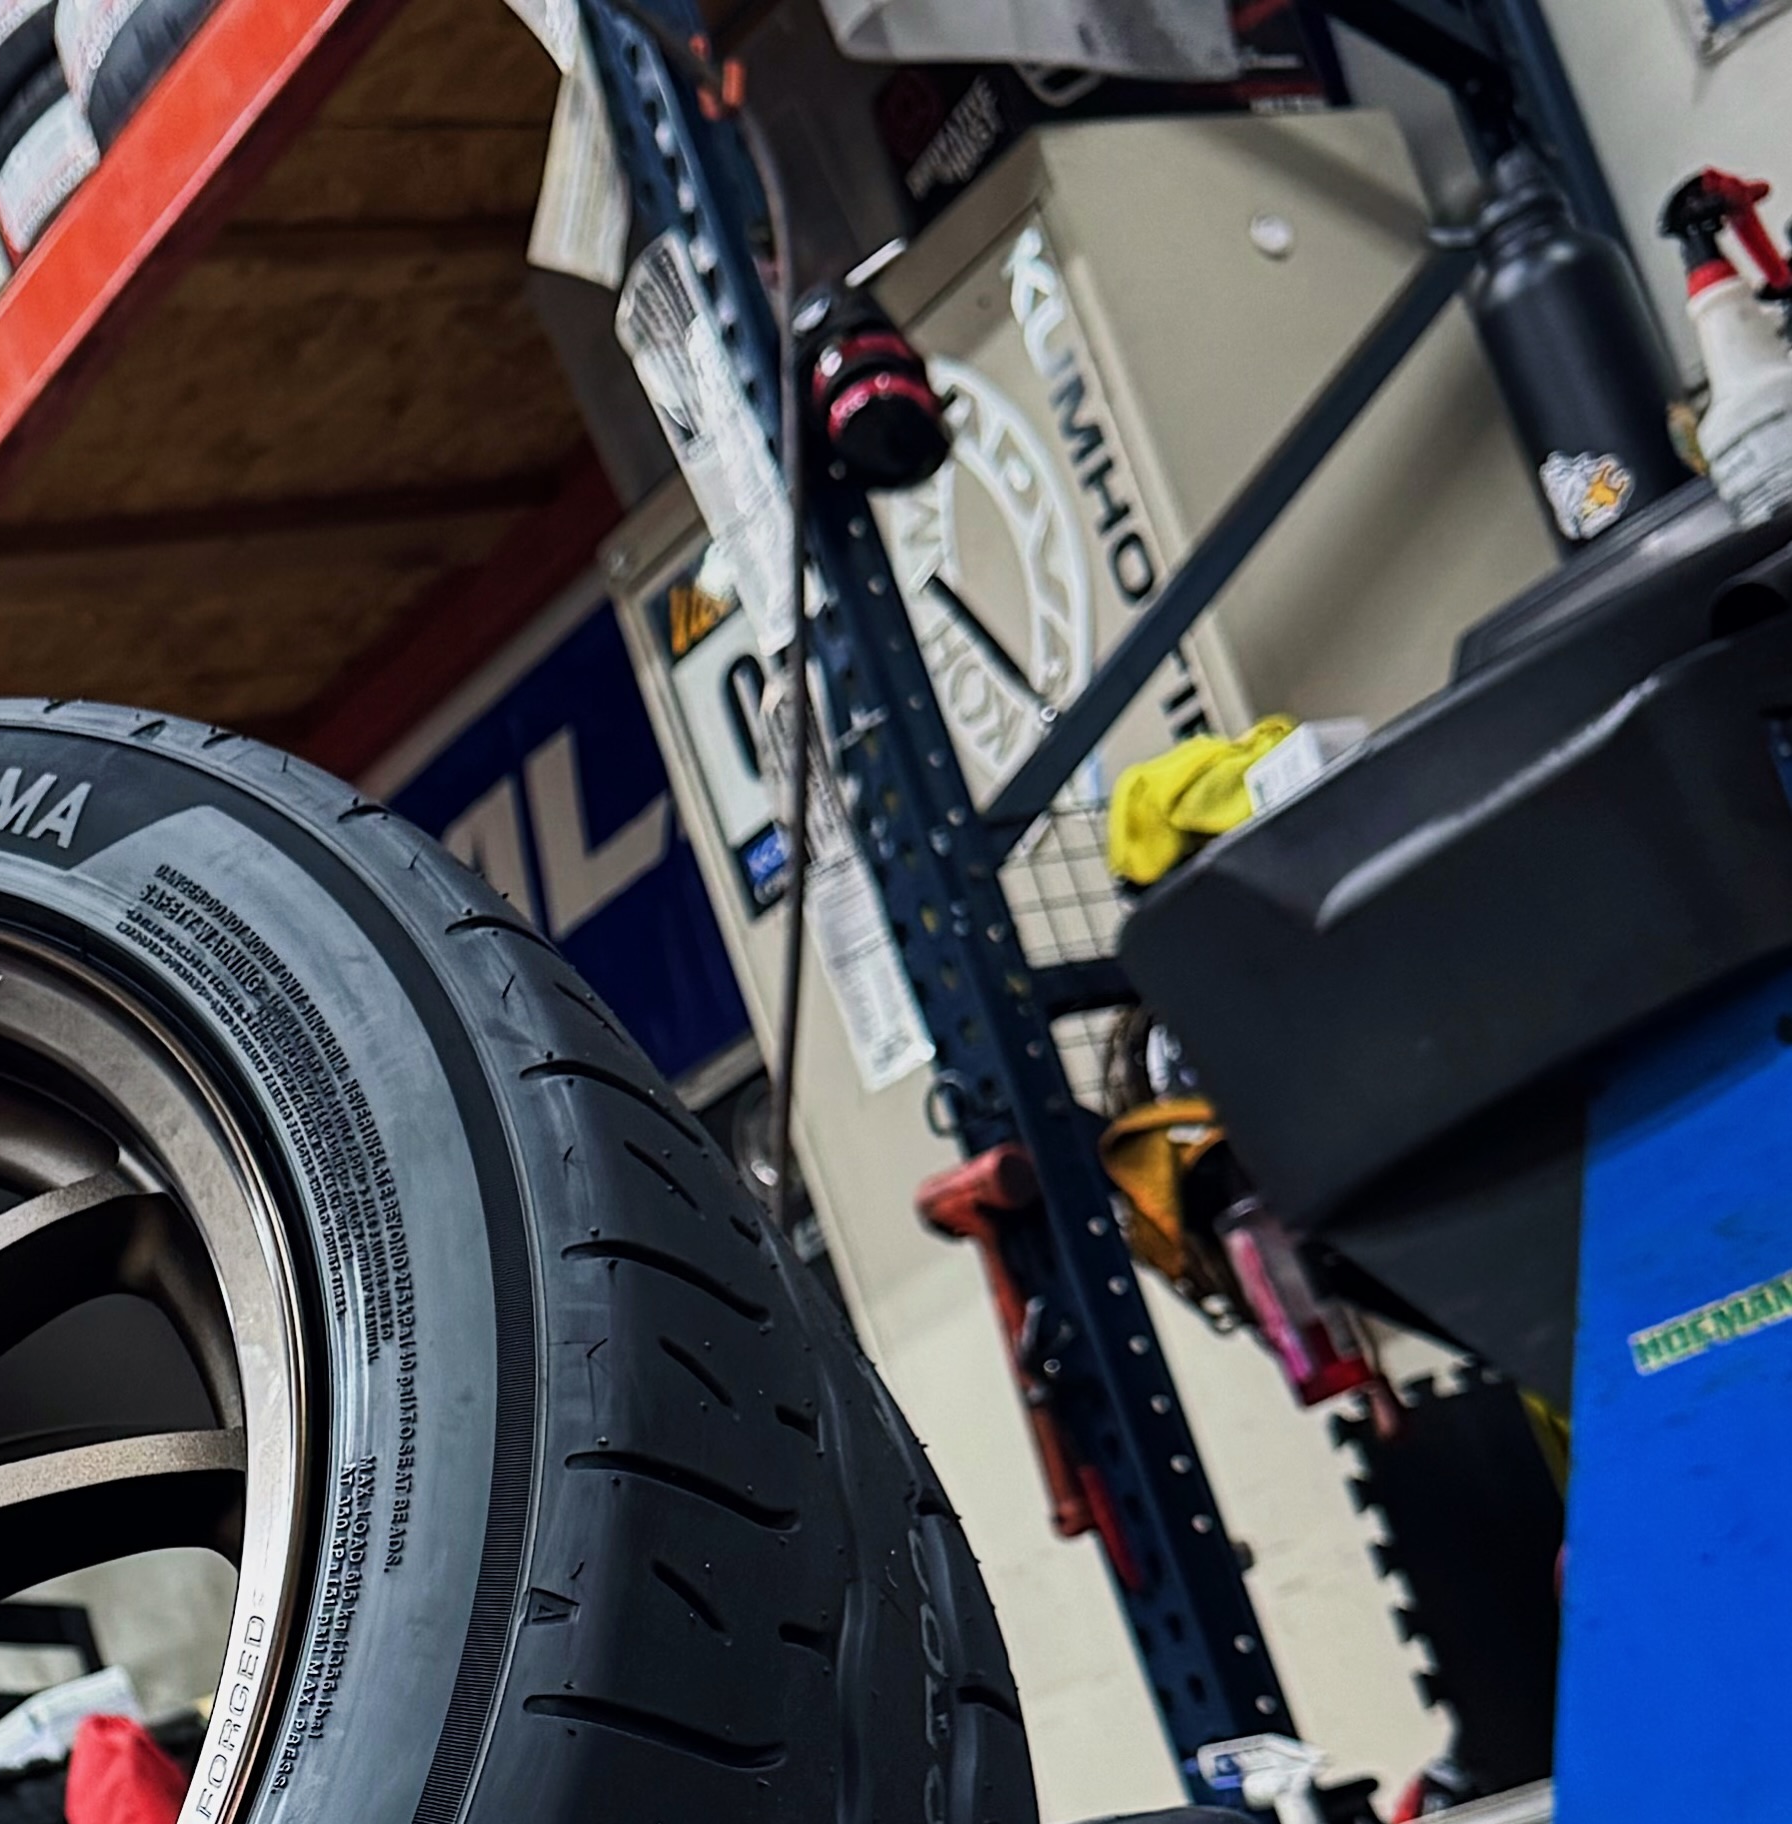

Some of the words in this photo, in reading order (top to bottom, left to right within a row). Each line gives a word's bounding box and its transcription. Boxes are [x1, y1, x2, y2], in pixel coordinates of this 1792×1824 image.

[379, 1197, 411, 1270] BEYOND
[394, 1443, 415, 1495] SEAT
[348, 1509, 370, 1563] LOAD
[384, 1499, 410, 1575] BEADS.
[196, 1615, 266, 1819] FORGED
[269, 1716, 307, 1797] PRESS.
